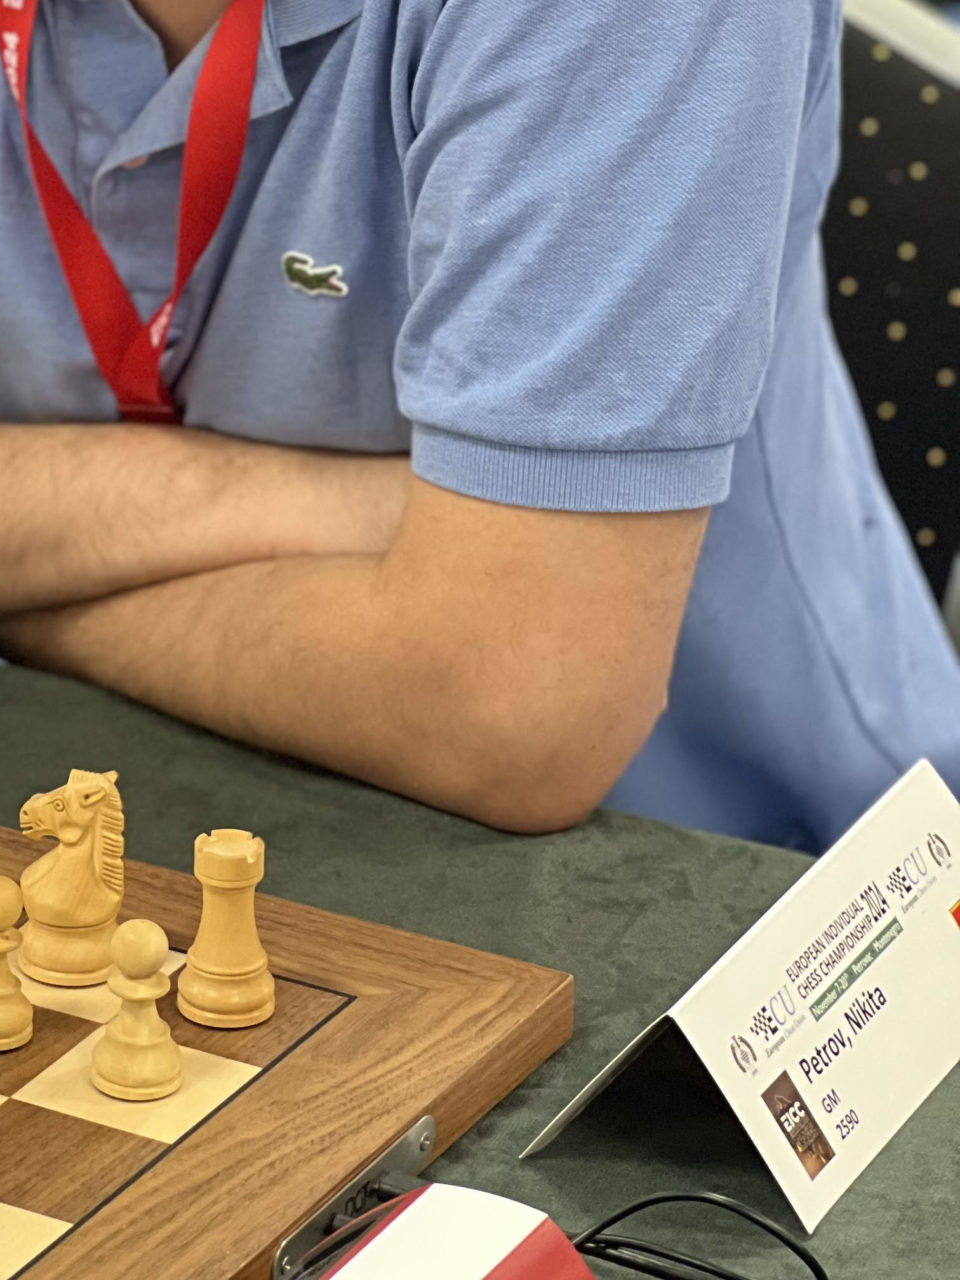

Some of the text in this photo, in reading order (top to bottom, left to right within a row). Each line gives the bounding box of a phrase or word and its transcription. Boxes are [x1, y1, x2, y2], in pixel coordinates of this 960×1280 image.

[786, 936, 827, 983] EUROPEAN
[822, 898, 865, 945] INDIVIDUAL
[859, 880, 891, 923] 2024
[797, 914, 875, 999] CHESS CHAMPIONSHIP
[798, 1028, 853, 1084] Petrov,
[843, 986, 887, 1036] Nikita
[780, 1100, 806, 1133] EICC
[821, 1088, 841, 1114] GM
[835, 1108, 860, 1141] 2590
